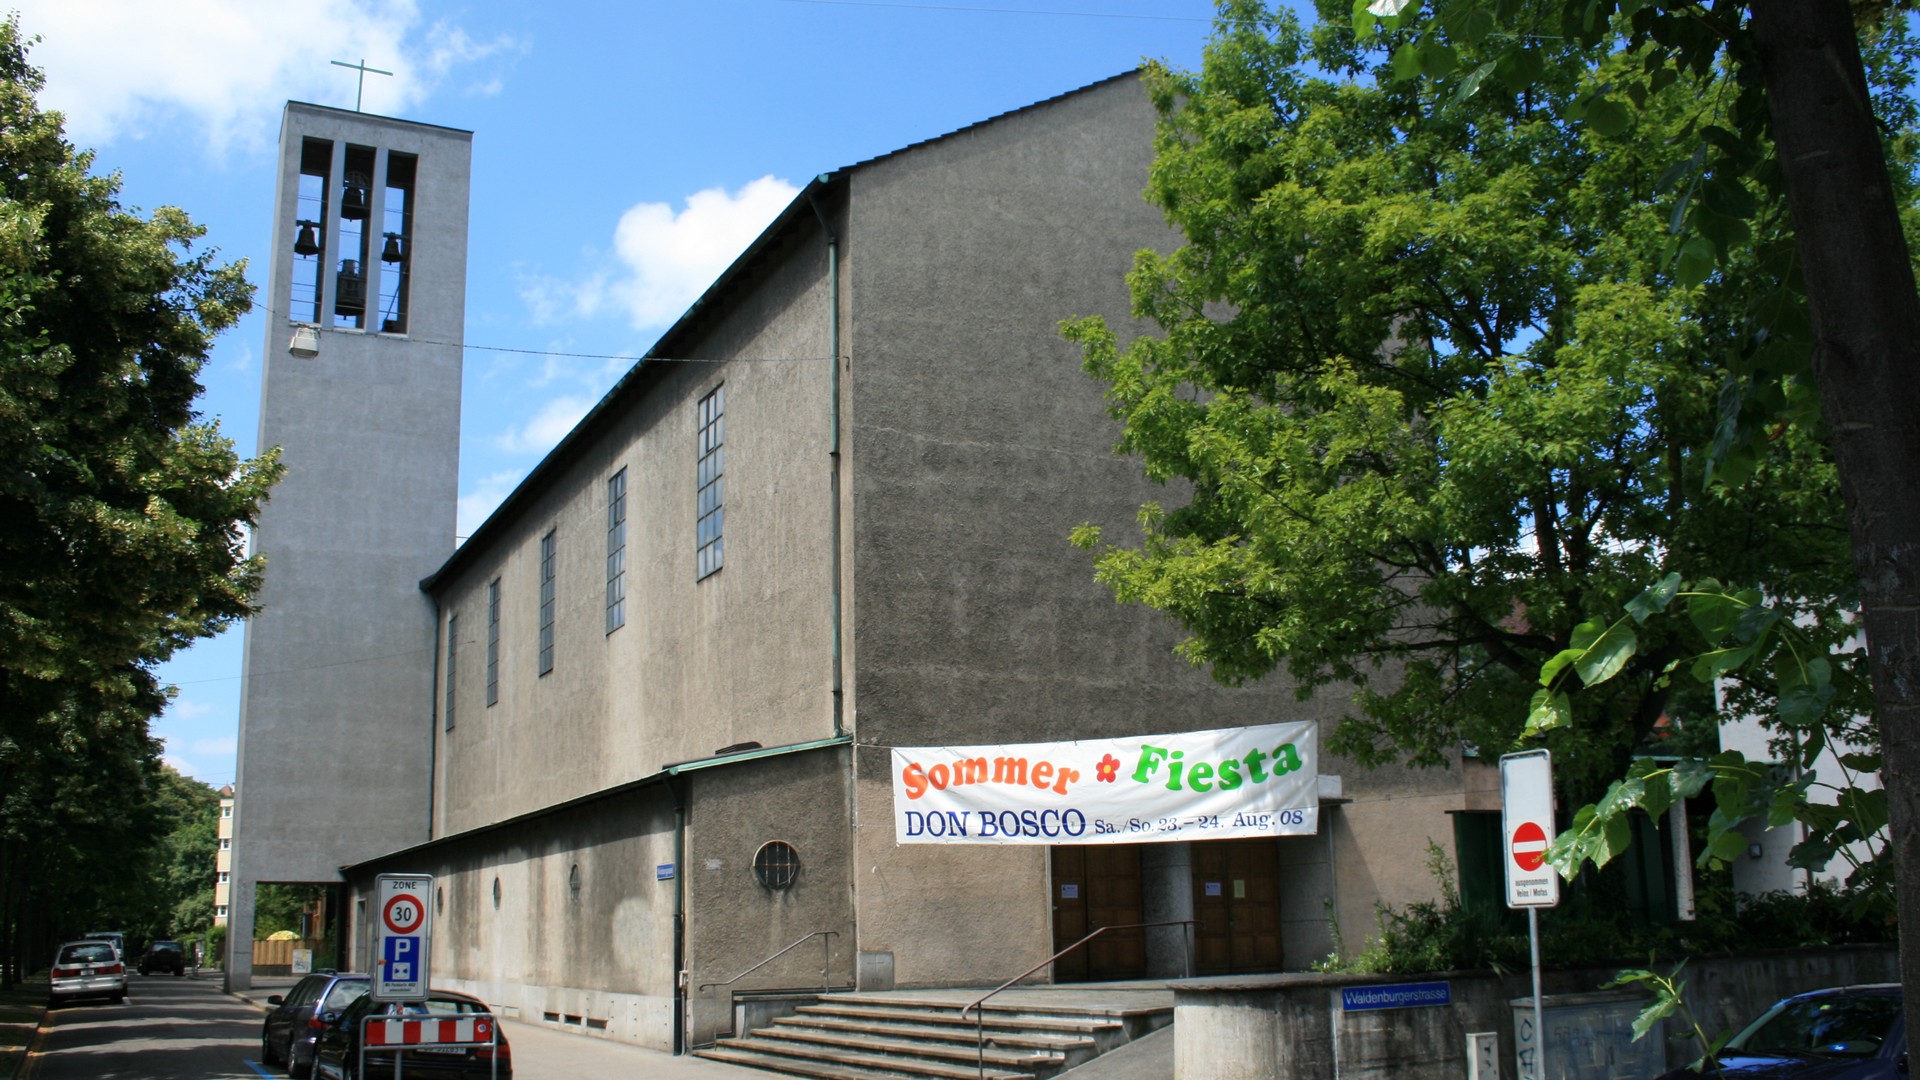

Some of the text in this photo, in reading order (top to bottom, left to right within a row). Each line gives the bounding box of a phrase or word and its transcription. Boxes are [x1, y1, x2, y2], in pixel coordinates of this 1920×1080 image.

[903, 743, 1303, 800] Sommer Fiesta
[905, 810, 971, 837] DON
[977, 808, 1087, 837] BOSCO
[1232, 812, 1276, 831] Aug.
[1280, 810, 1304, 826] 08
[392, 881, 417, 890] ZONE
[394, 906, 412, 922] 30
[394, 938, 411, 962] P
[1344, 989, 1447, 1006] Waldenburgerstrasse
